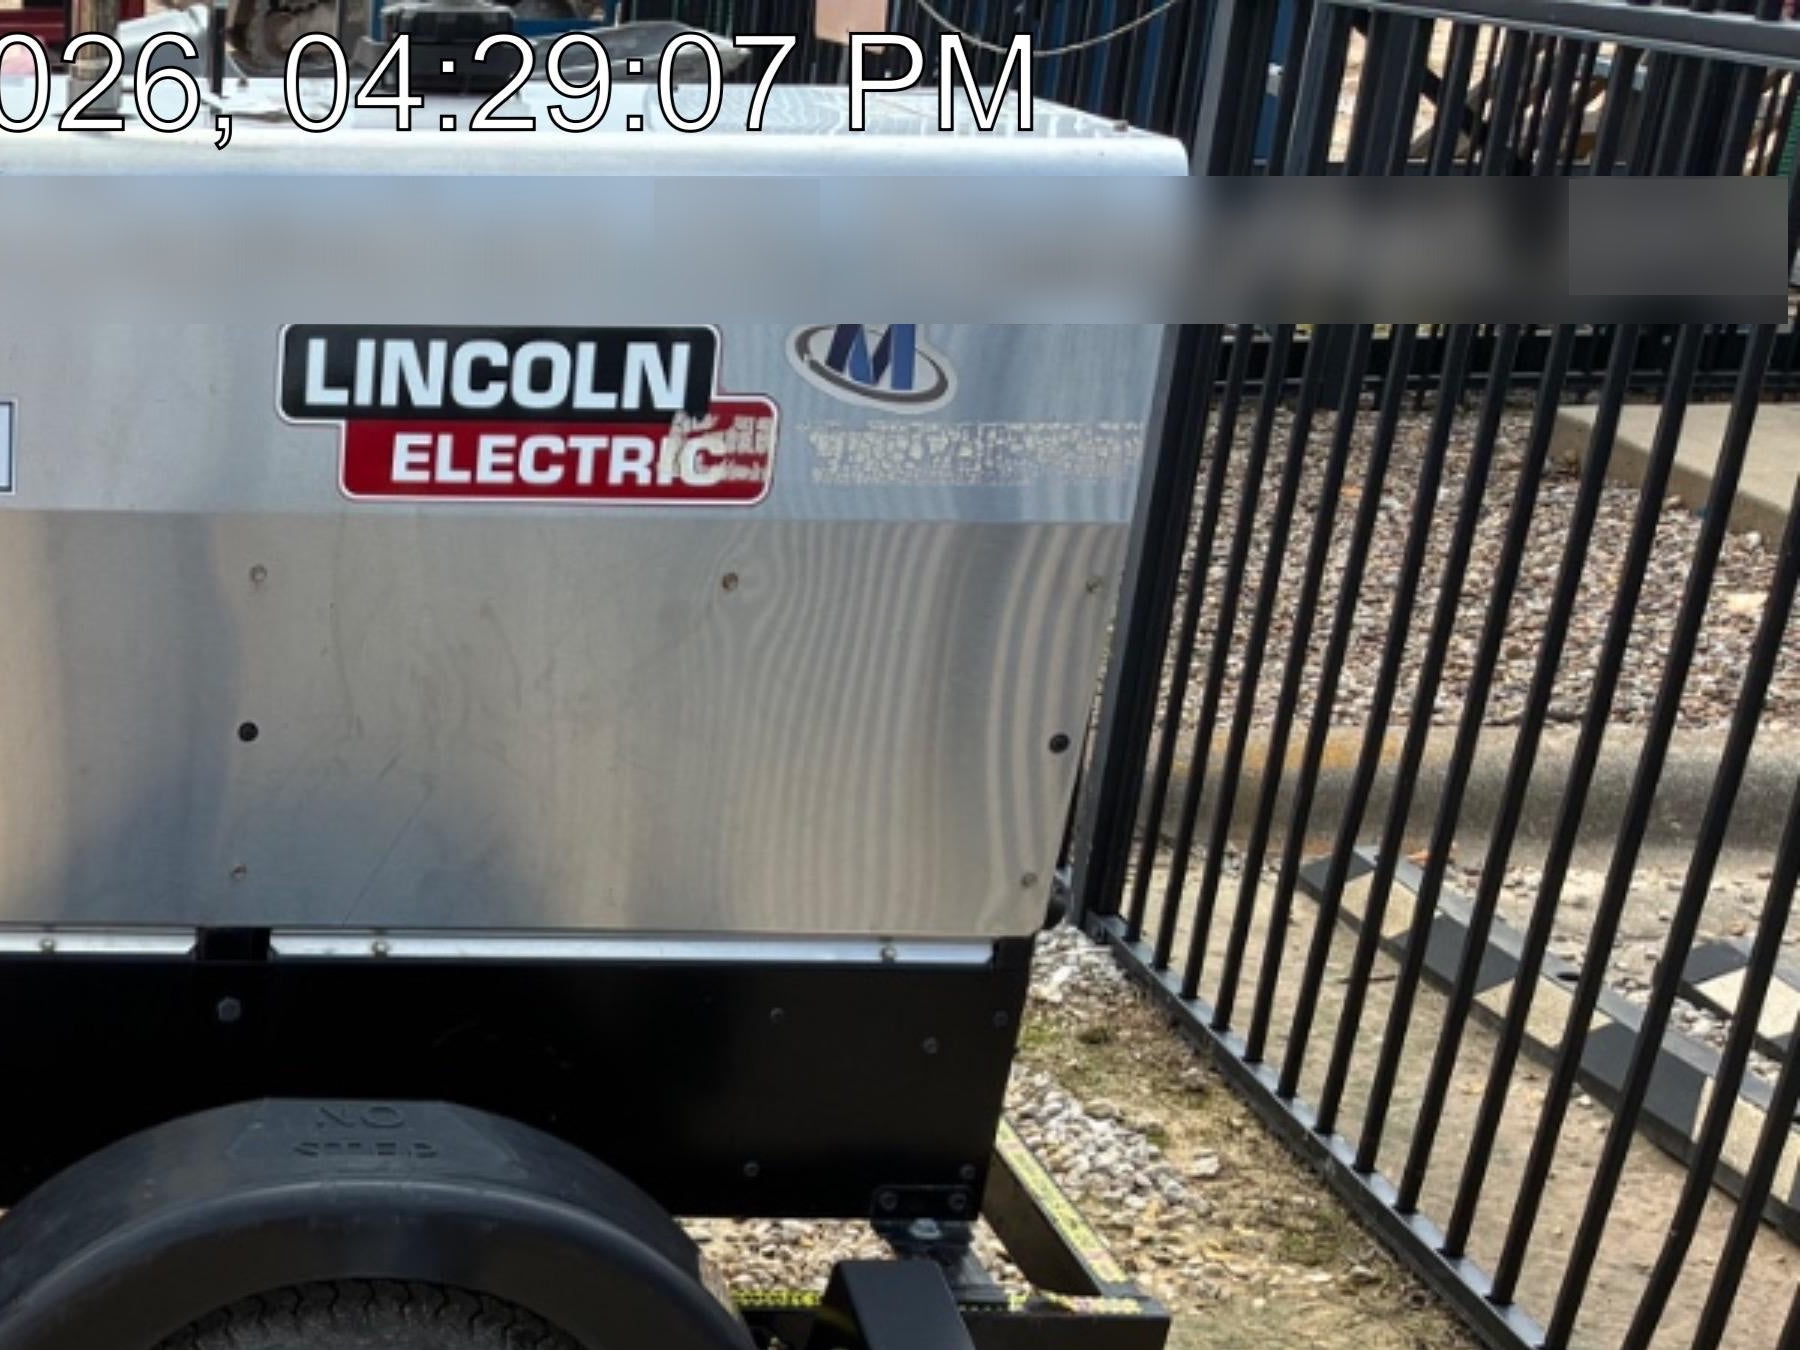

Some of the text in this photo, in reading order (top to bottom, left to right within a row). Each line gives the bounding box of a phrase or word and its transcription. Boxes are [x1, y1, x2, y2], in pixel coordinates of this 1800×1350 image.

[305, 338, 691, 410] LINCOLN
[391, 433, 726, 487] ELECTRIC
[314, 1105, 406, 1128] NO
